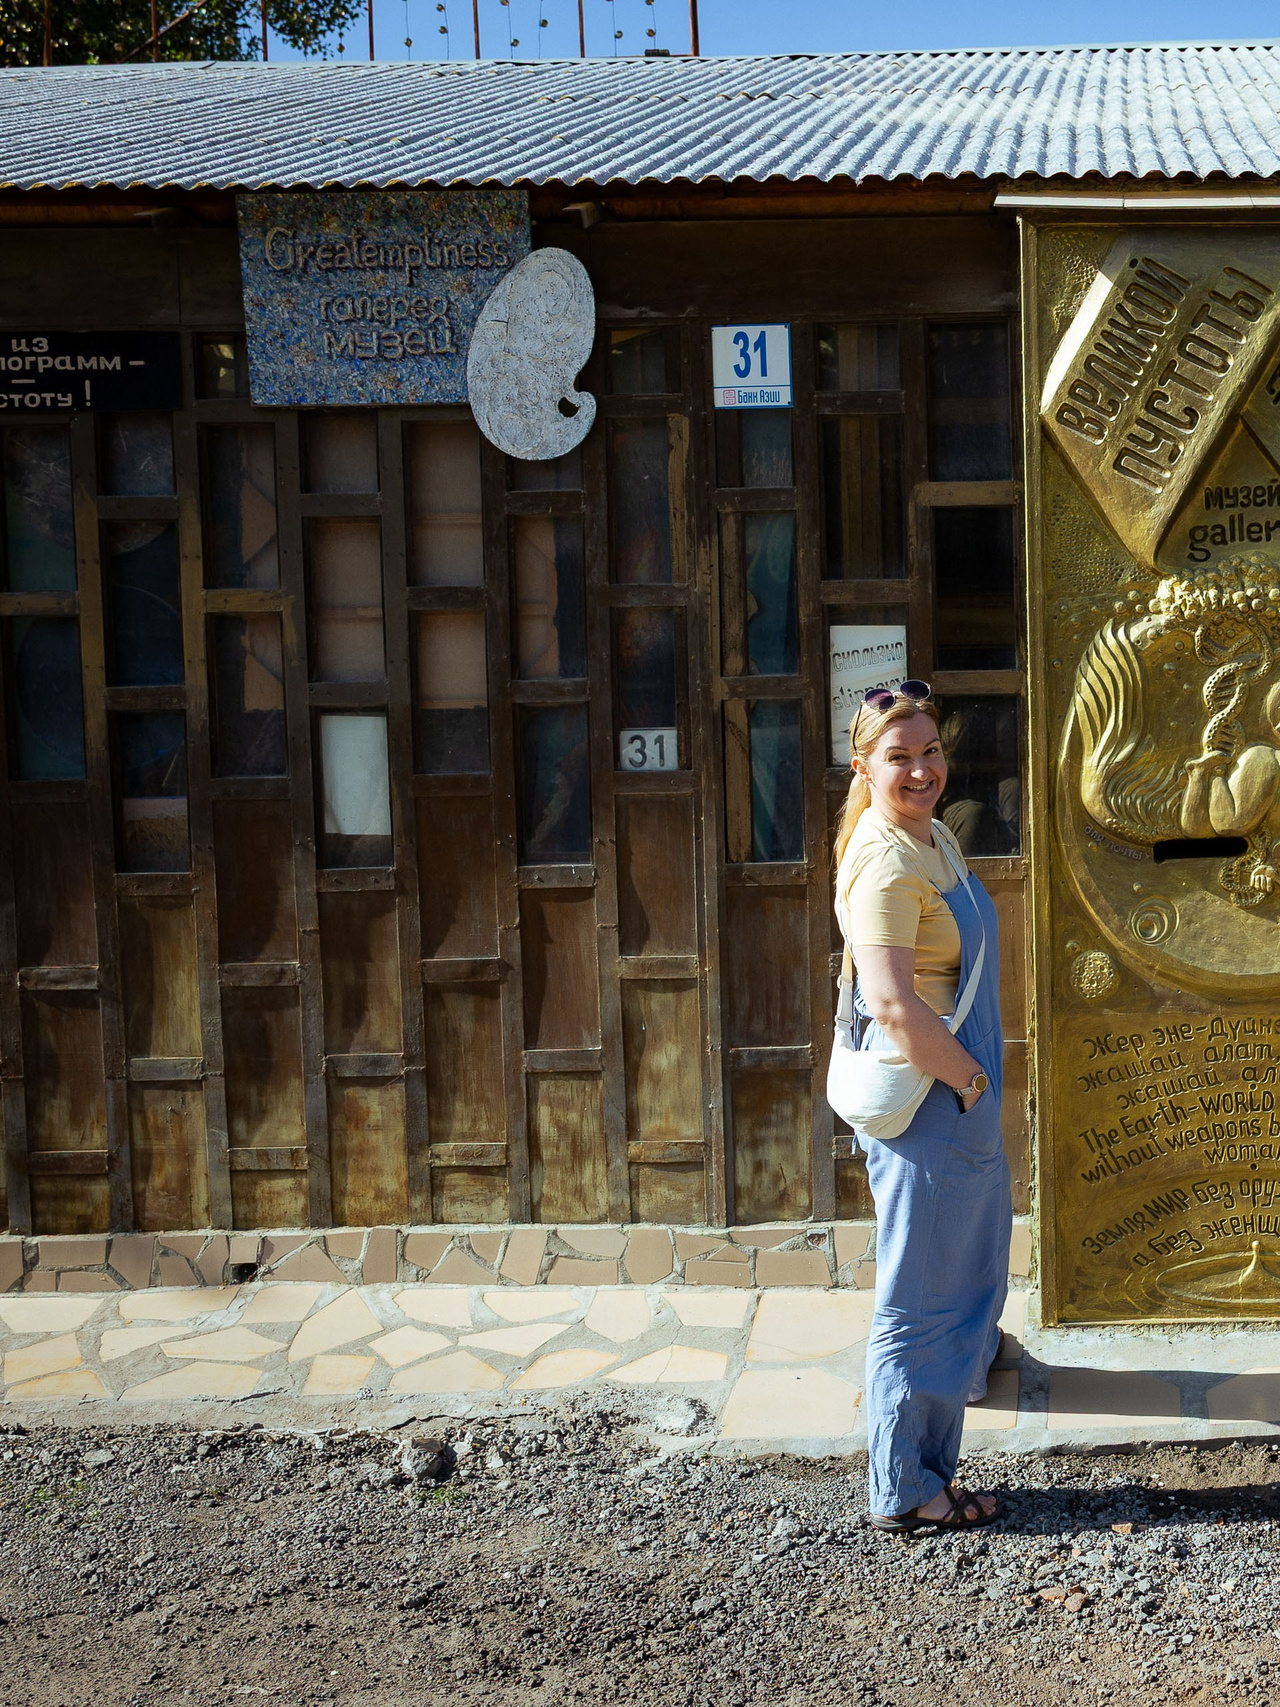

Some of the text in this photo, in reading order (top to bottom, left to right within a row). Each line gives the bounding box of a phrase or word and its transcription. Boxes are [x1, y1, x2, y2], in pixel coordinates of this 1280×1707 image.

[321, 295, 452, 329] галерея
[11, 336, 49, 353] из
[733, 331, 767, 378] 31
[1056, 257, 1192, 444] ВЕЛИКОЙ
[738, 389, 780, 404] Банк Азии
[1112, 266, 1276, 494] ПУСТОТЫ
[832, 641, 904, 673] СКОЛЬЗКО
[628, 734, 665, 768] 31
[1083, 1033, 1145, 1060] Жер
[1078, 1049, 1188, 1093] жашай
[1203, 1042, 1280, 1065] алат,
[1117, 1067, 1223, 1110] жашай
[1079, 1127, 1122, 1154] The
[1081, 1133, 1168, 1185] without
[1165, 1117, 1263, 1152] weapons
[1082, 1212, 1156, 1256] Земля
[1143, 1188, 1192, 1221] МИР
[1191, 1179, 1236, 1210] без
[1133, 1252, 1155, 1267] а
[1148, 1230, 1204, 1257] без
